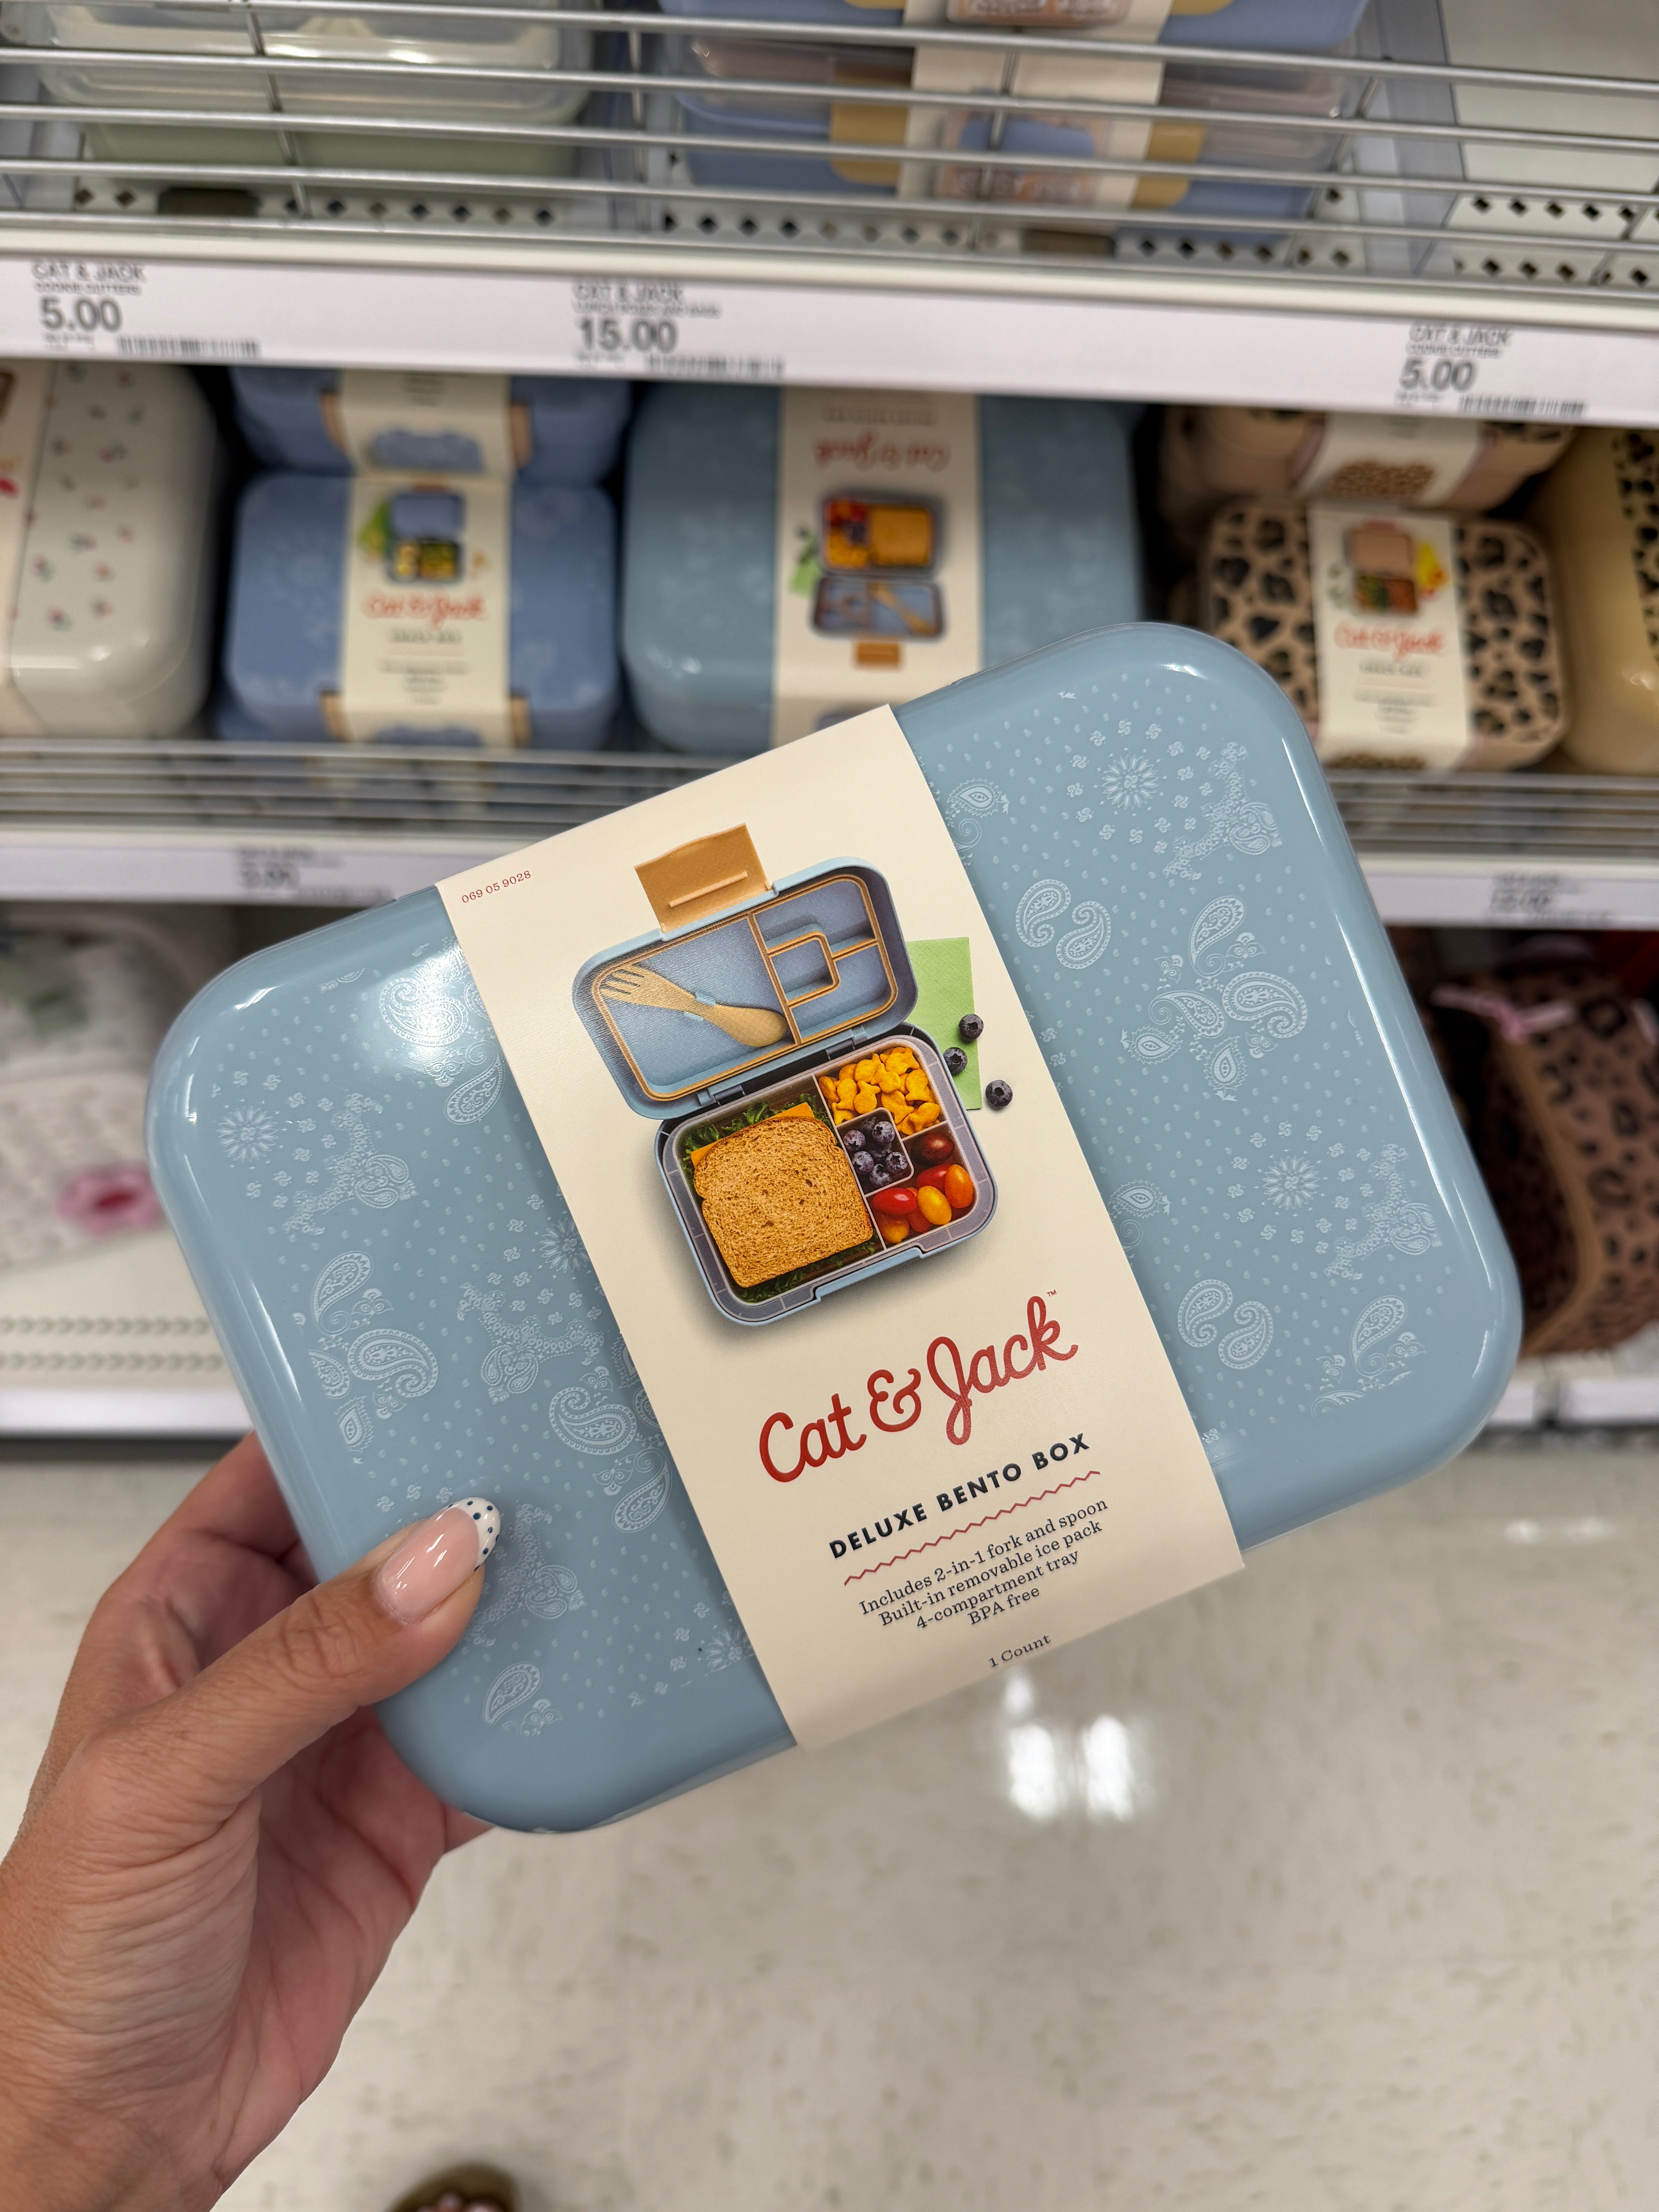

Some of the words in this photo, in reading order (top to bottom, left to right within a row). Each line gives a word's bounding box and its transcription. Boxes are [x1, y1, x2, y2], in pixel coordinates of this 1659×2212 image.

[33, 262, 70, 280] CAT
[76, 263, 90, 282] &
[94, 263, 145, 283] JACK
[572, 283, 613, 301] CAT
[634, 284, 685, 304] JACK
[40, 295, 122, 332] 5.00
[577, 318, 678, 354] 15.00
[1409, 323, 1448, 342] CAT
[1465, 327, 1512, 347] JACK
[1399, 358, 1476, 393] 5.00
[462, 890, 483, 903] 069
[486, 883, 500, 893] 05
[502, 871, 531, 887] 9028
[759, 1393, 867, 1482] Cat
[867, 1368, 921, 1432] &
[927, 1296, 1078, 1445] Jack
[829, 1503, 927, 1558] DELUXE
[936, 1463, 1021, 1511] BENTO
[1032, 1433, 1089, 1470] BOX
[859, 1575, 932, 1615] Includes
[934, 1550, 986, 1582] 2-in-1
[987, 1535, 1023, 1558] fork
[1025, 1519, 1056, 1542] and
[1058, 1500, 1108, 1530] spoon
[879, 1590, 946, 1626] Built-in
[948, 1550, 1033, 1596] removable
[1035, 1540, 1060, 1558] ice
[1062, 1519, 1103, 1547] pack
[916, 1564, 1044, 1629] 4-compartment
[1045, 1549, 1079, 1572] tray
[967, 1601, 1006, 1625] BPA
[1006, 1586, 1041, 1608] free
[989, 1657, 998, 1668] 1
[1001, 1635, 1051, 1661] Count
